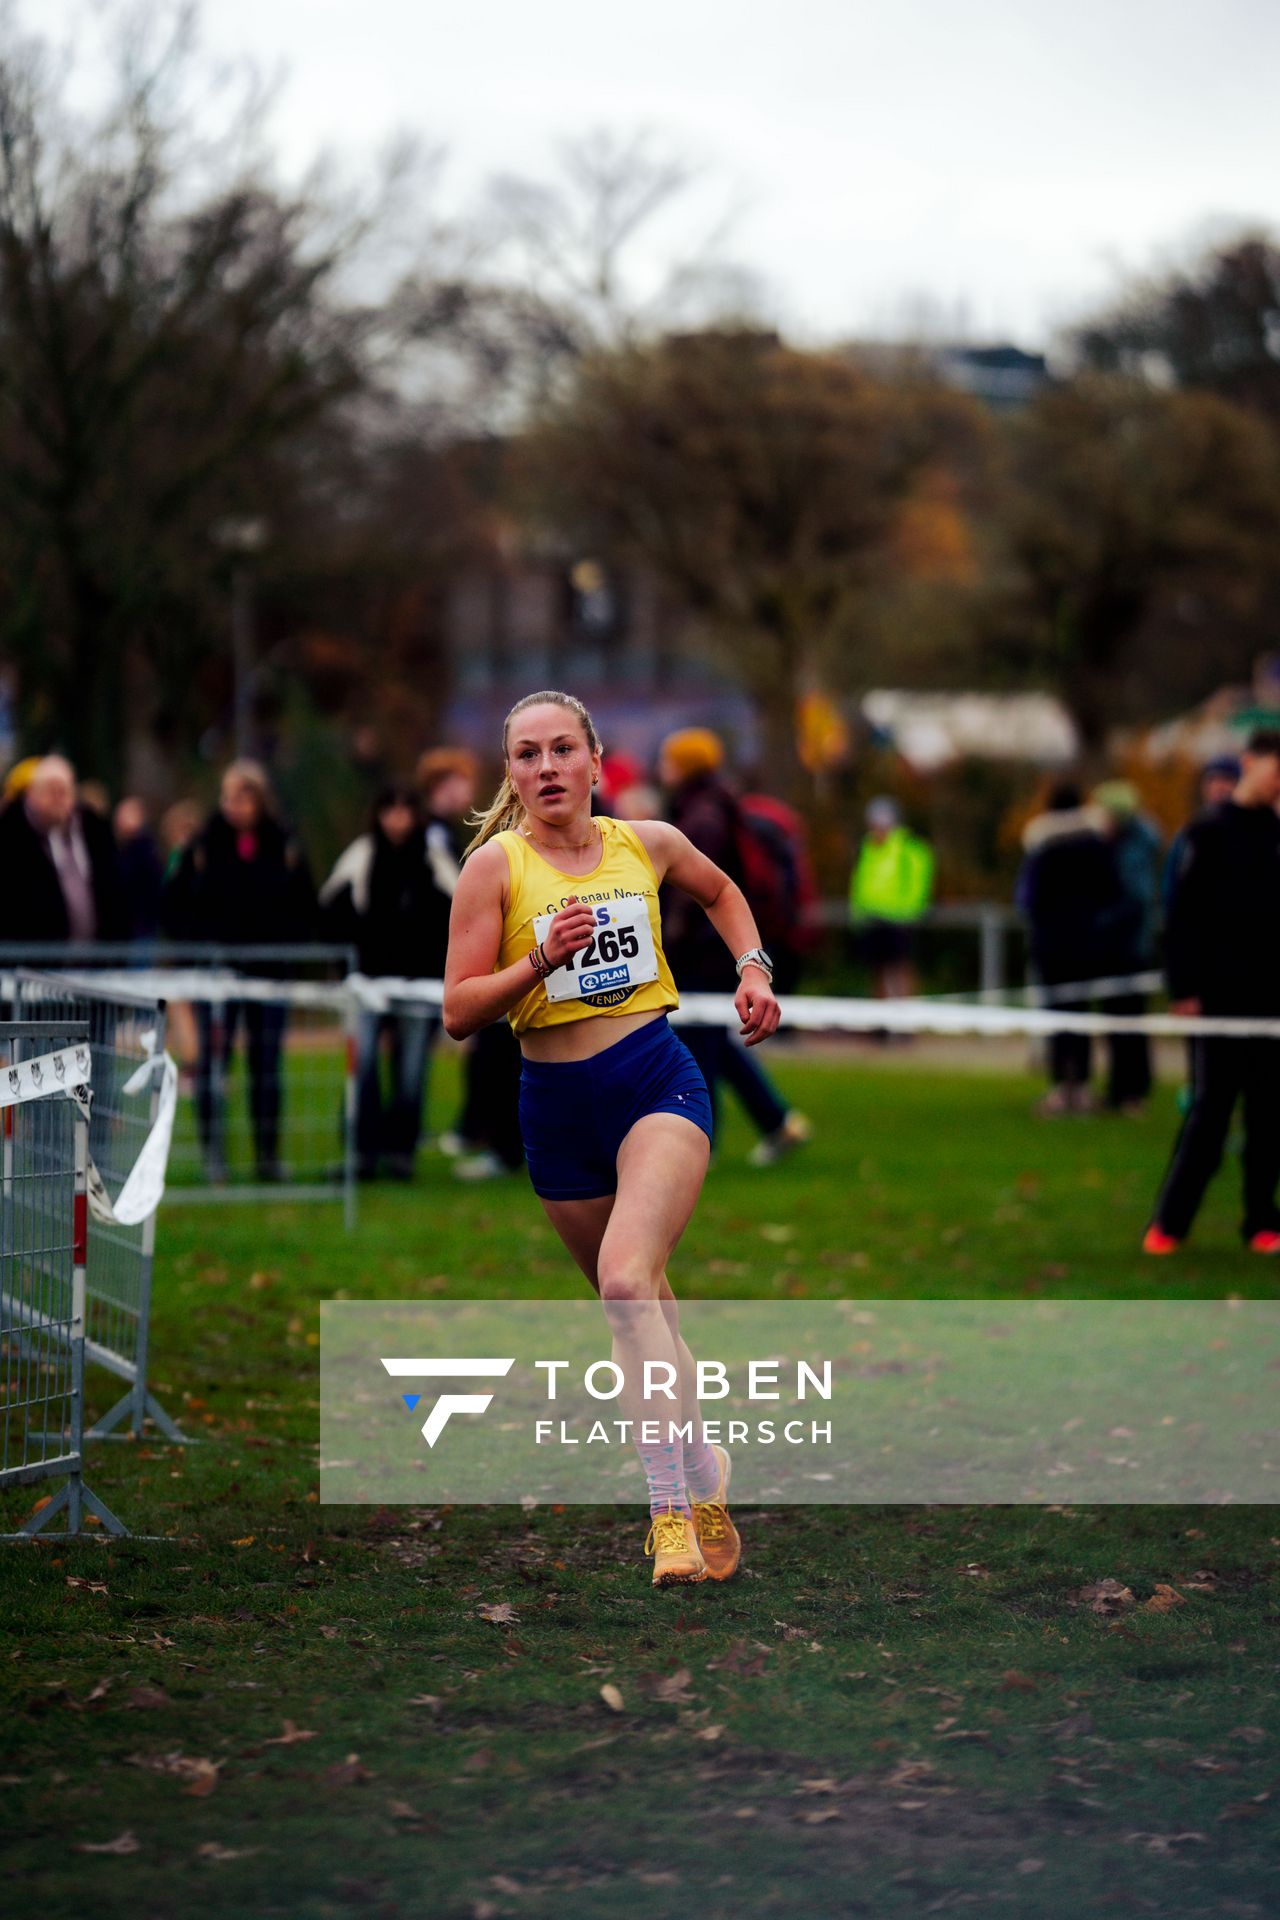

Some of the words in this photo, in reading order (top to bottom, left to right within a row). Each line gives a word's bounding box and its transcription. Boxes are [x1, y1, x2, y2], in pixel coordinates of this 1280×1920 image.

[560, 891, 611, 910] Otenau
[599, 968, 628, 983] PLAN
[585, 990, 626, 1005] TENAU
